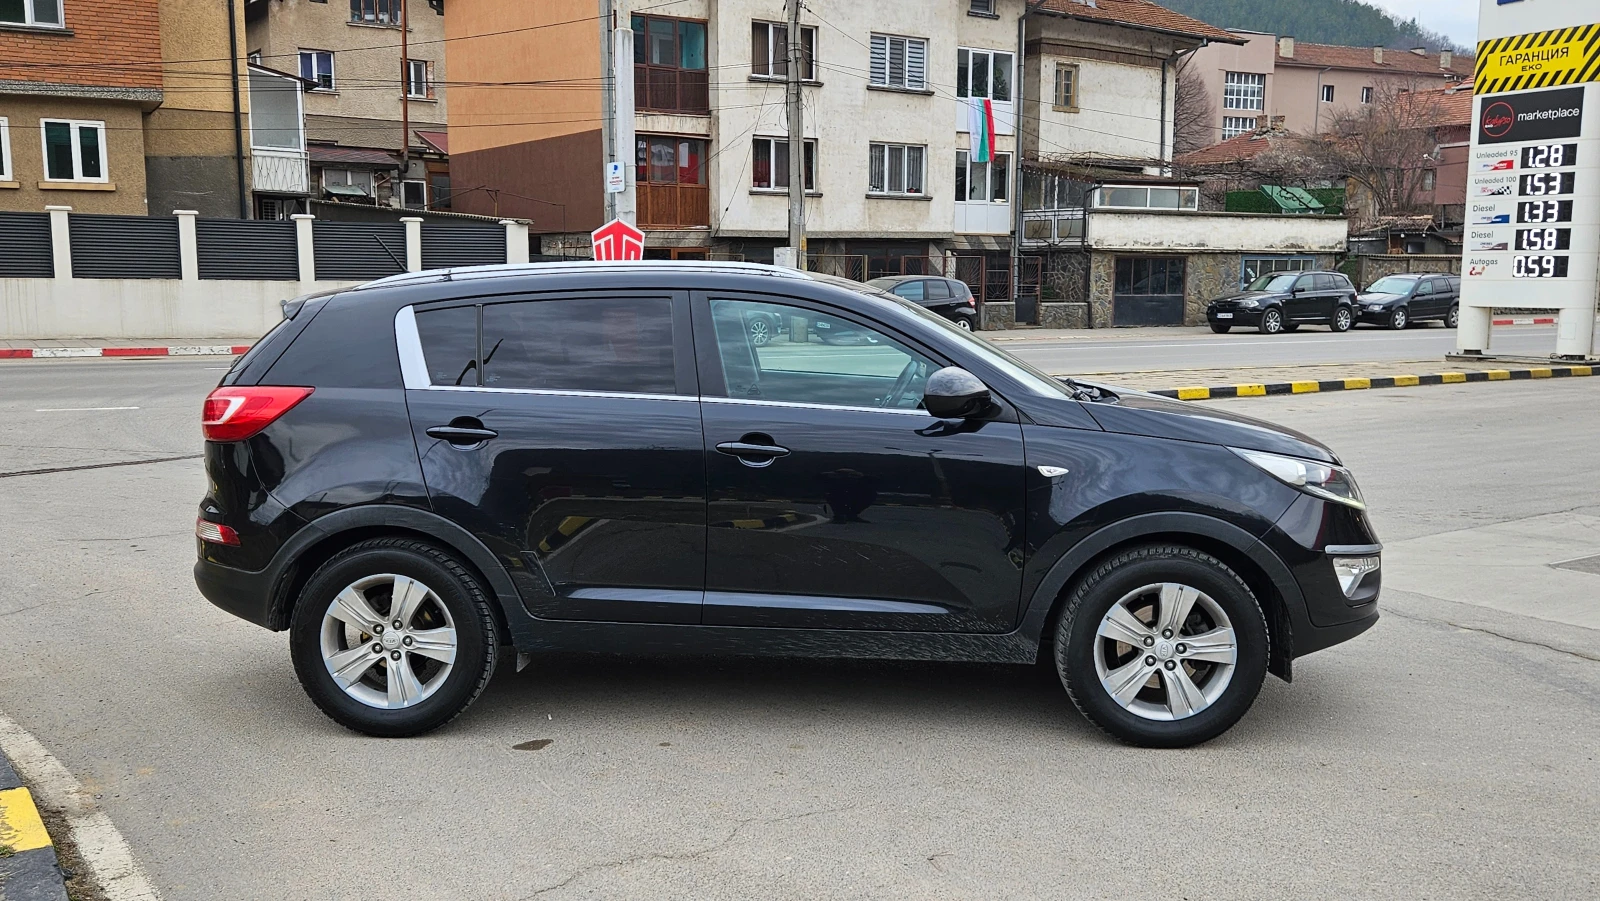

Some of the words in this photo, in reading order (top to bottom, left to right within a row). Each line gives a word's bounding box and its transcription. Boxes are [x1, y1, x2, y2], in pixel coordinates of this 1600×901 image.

[1500, 46, 1569, 66] ГАРАНЦИЯ
[1517, 107, 1580, 122] marketplace
[1476, 149, 1508, 159] Unleaded
[1509, 149, 1518, 157] 95
[1474, 177, 1504, 185] Unleaded
[1472, 203, 1496, 212] Diesel
[1471, 231, 1494, 239] Diesel
[1469, 258, 1498, 267] Autogas
[1512, 255, 1555, 278] 0.59
